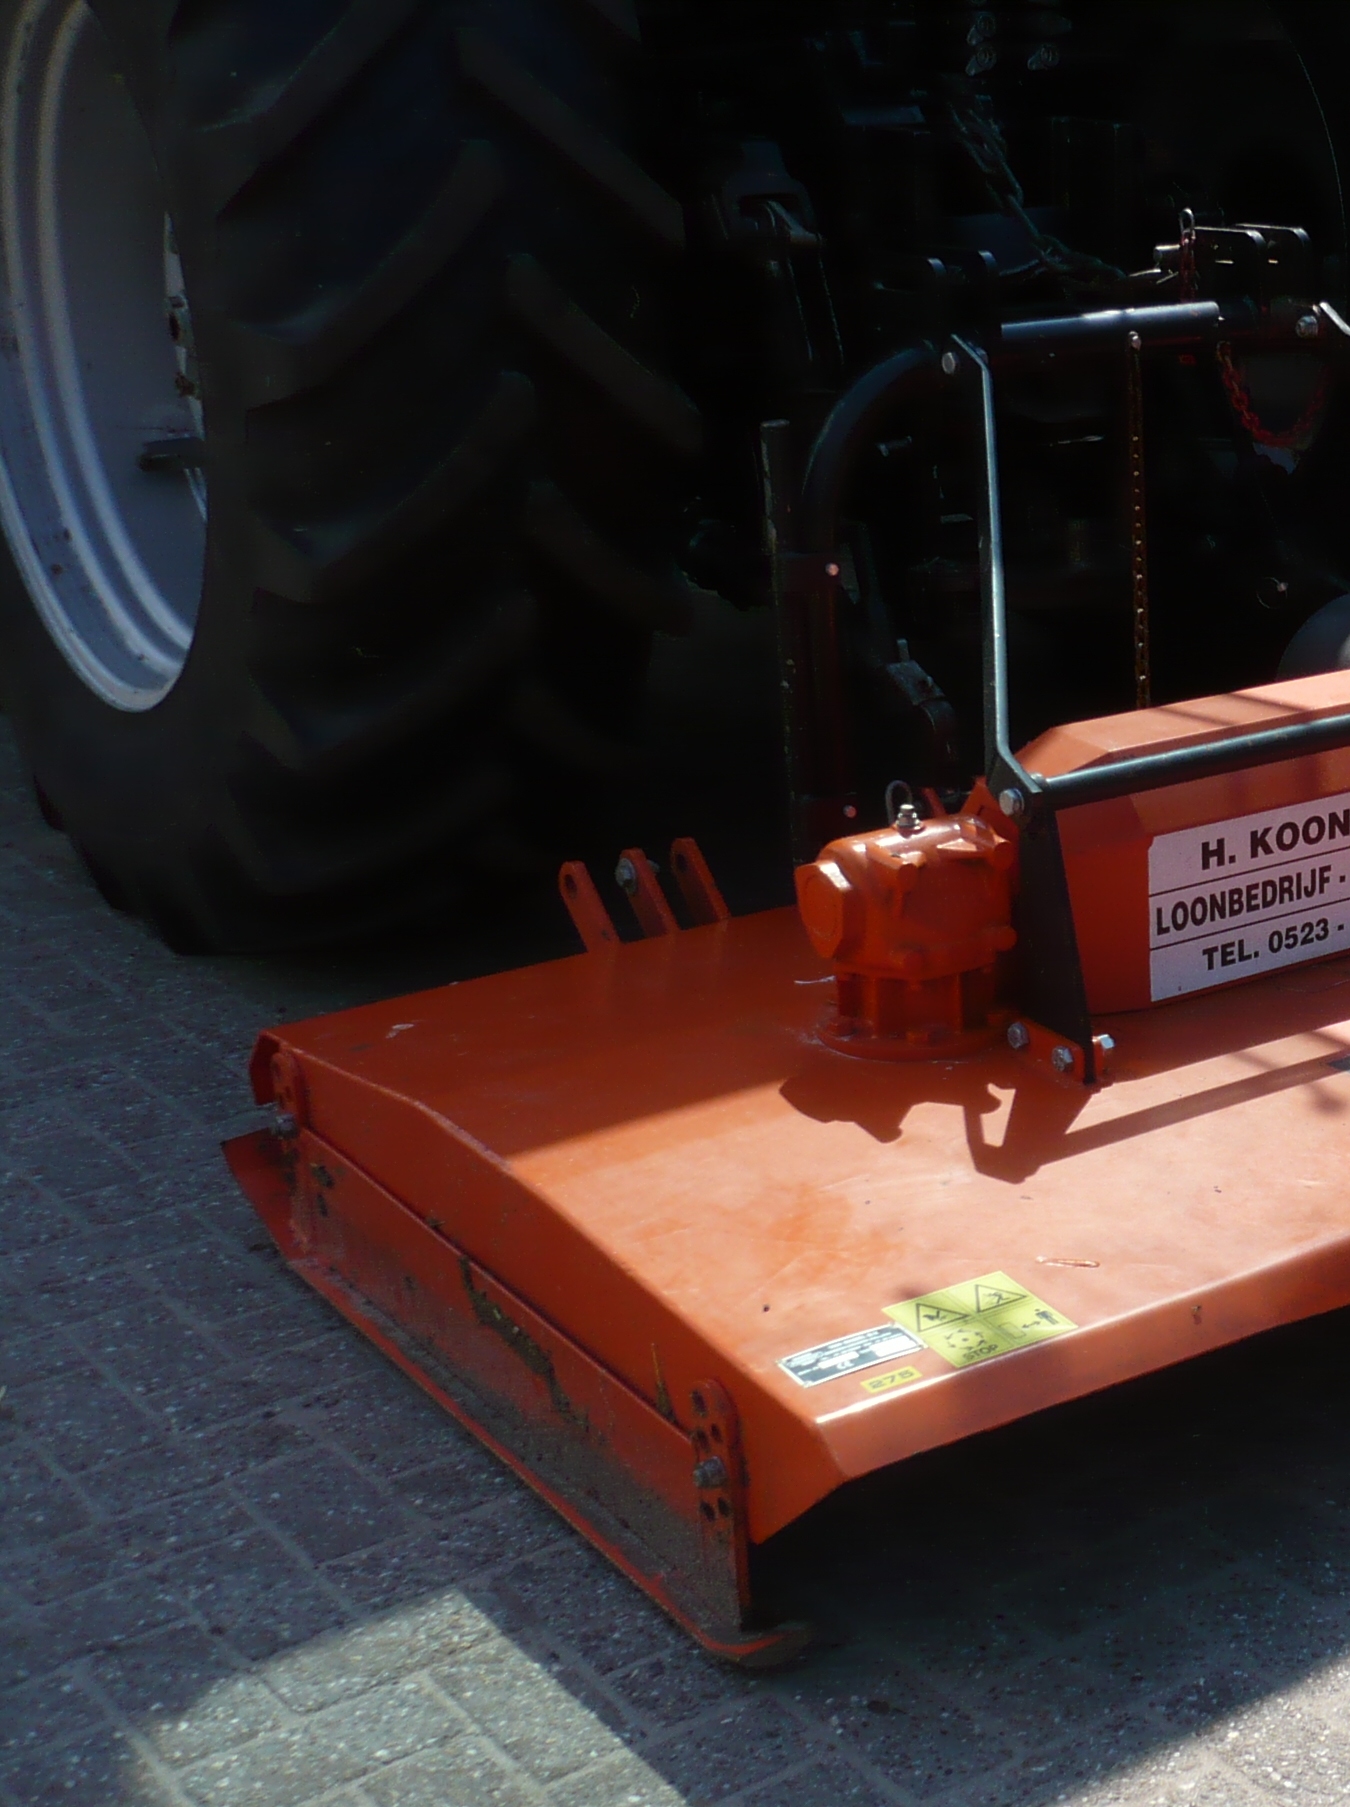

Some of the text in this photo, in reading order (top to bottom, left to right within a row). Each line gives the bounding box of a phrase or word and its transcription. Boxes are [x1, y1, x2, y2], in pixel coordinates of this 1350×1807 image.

[1201, 837, 1236, 871] H.
[1156, 864, 1332, 936] LOONBEDRIJF
[1202, 940, 1260, 972] TEL.
[1268, 917, 1330, 954] 0523
[962, 1343, 999, 1362] STOP
[868, 1369, 915, 1390] 275
